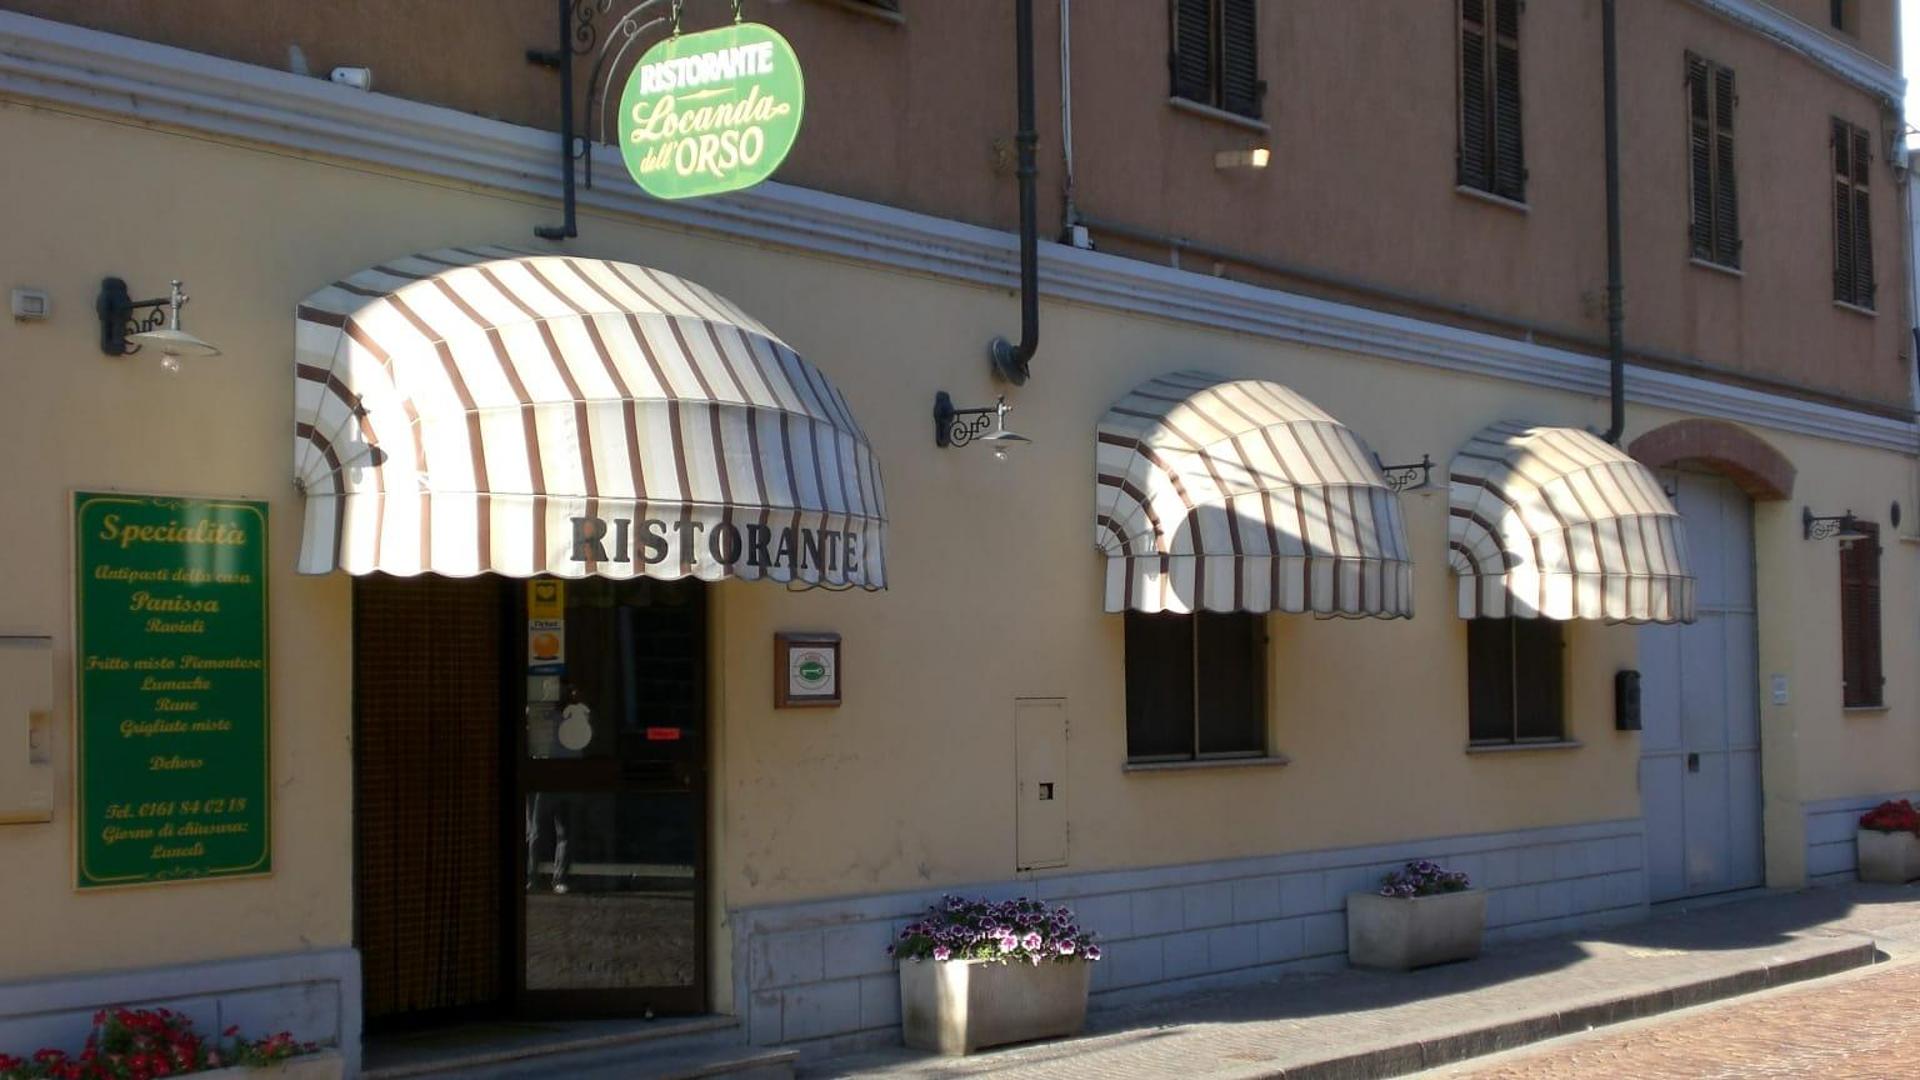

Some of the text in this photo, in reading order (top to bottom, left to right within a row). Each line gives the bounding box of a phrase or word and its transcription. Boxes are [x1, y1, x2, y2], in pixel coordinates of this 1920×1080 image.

[640, 41, 774, 95] RISTORANTE
[631, 85, 790, 143] Locanda
[100, 513, 246, 549] Specialità
[570, 517, 859, 573] RISTORANTE
[94, 564, 169, 584] Antipasti
[172, 566, 212, 584] della
[129, 590, 220, 613] Panissa
[145, 618, 205, 634] Ravioli
[86, 654, 262, 670] Fritto misto Piemontese
[140, 676, 211, 692] Lumache
[154, 697, 199, 711] Rane
[120, 718, 188, 738] Grigliate
[149, 755, 204, 771] Dehors
[138, 801, 175, 817] 0161
[101, 826, 154, 846] Giorno
[157, 823, 175, 838] di
